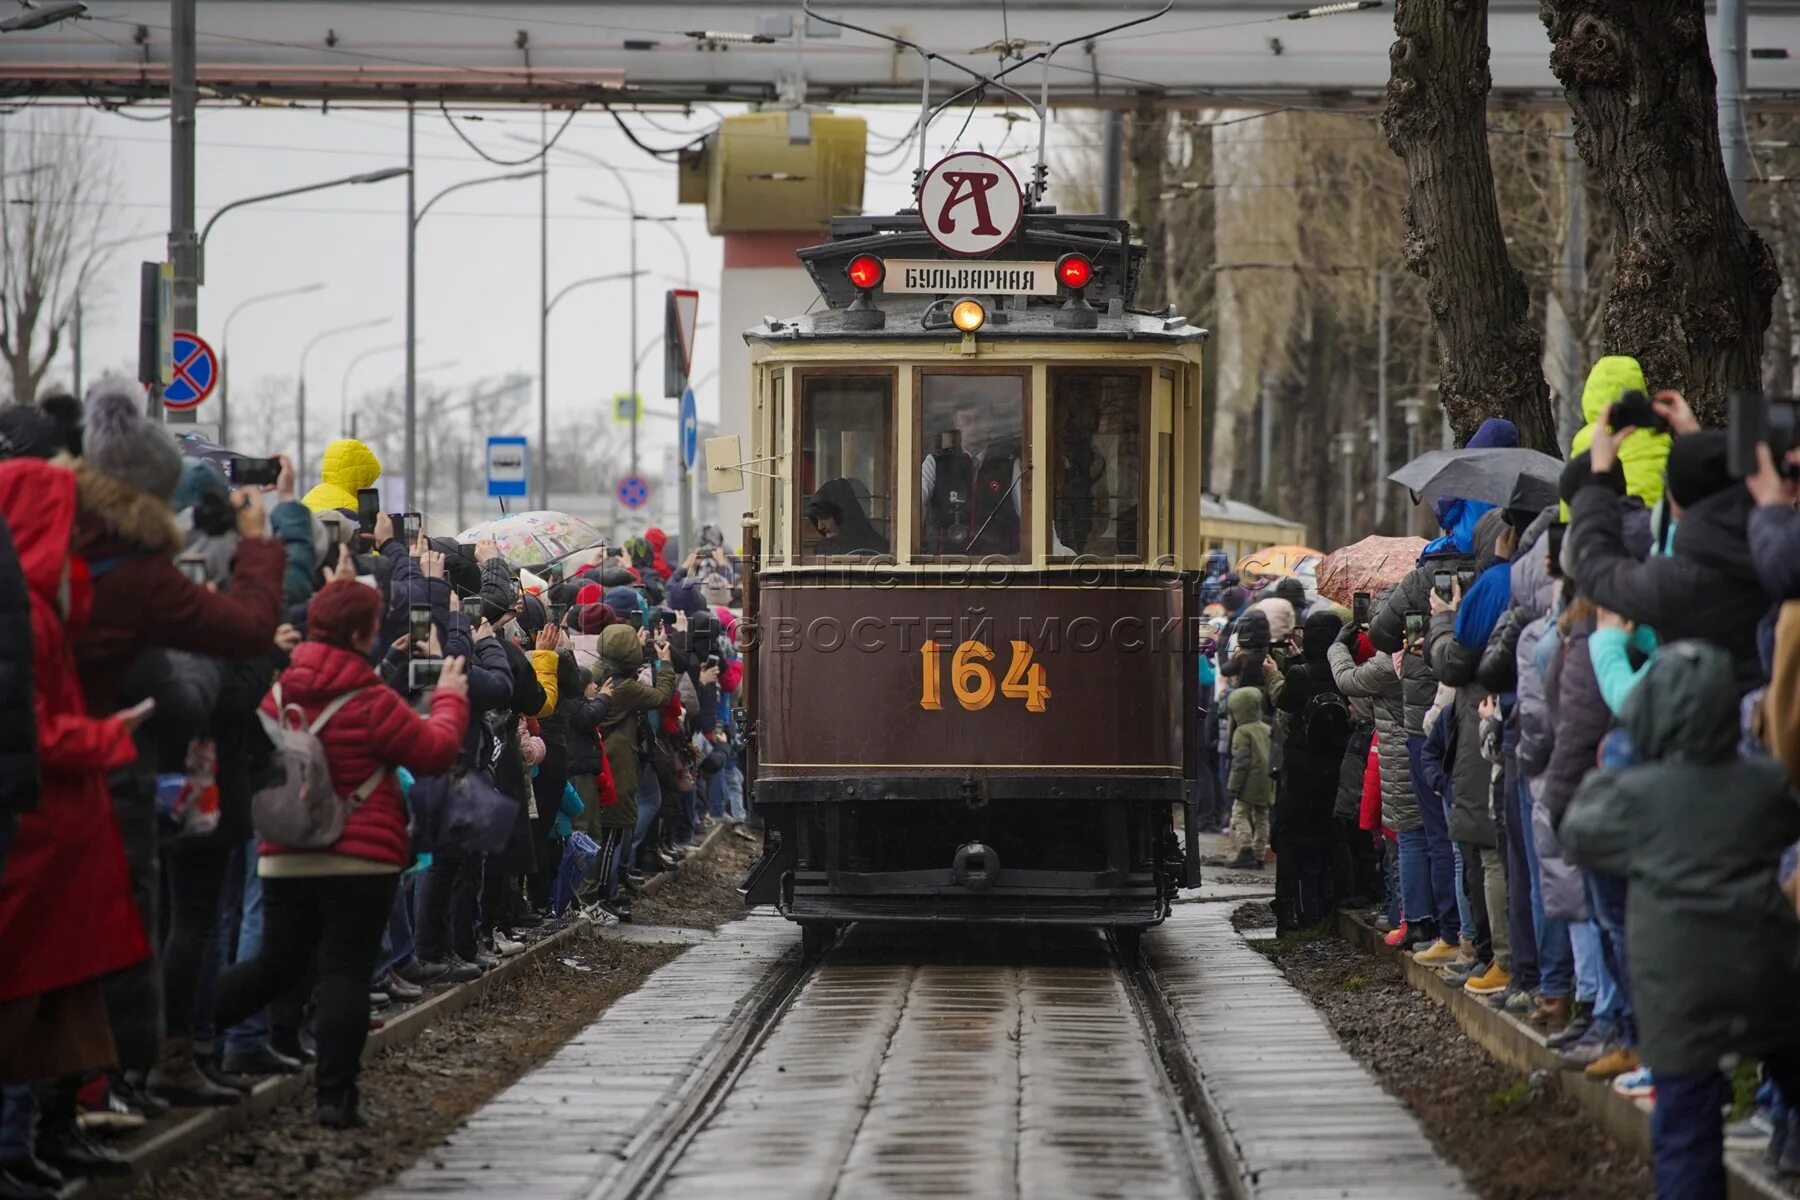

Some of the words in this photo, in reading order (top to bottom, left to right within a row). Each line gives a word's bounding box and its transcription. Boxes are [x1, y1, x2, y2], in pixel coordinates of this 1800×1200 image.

[938, 172, 1001, 236] А
[905, 268, 1035, 291] БУЛЬВАРНАЯ
[920, 639, 1052, 712] 164
